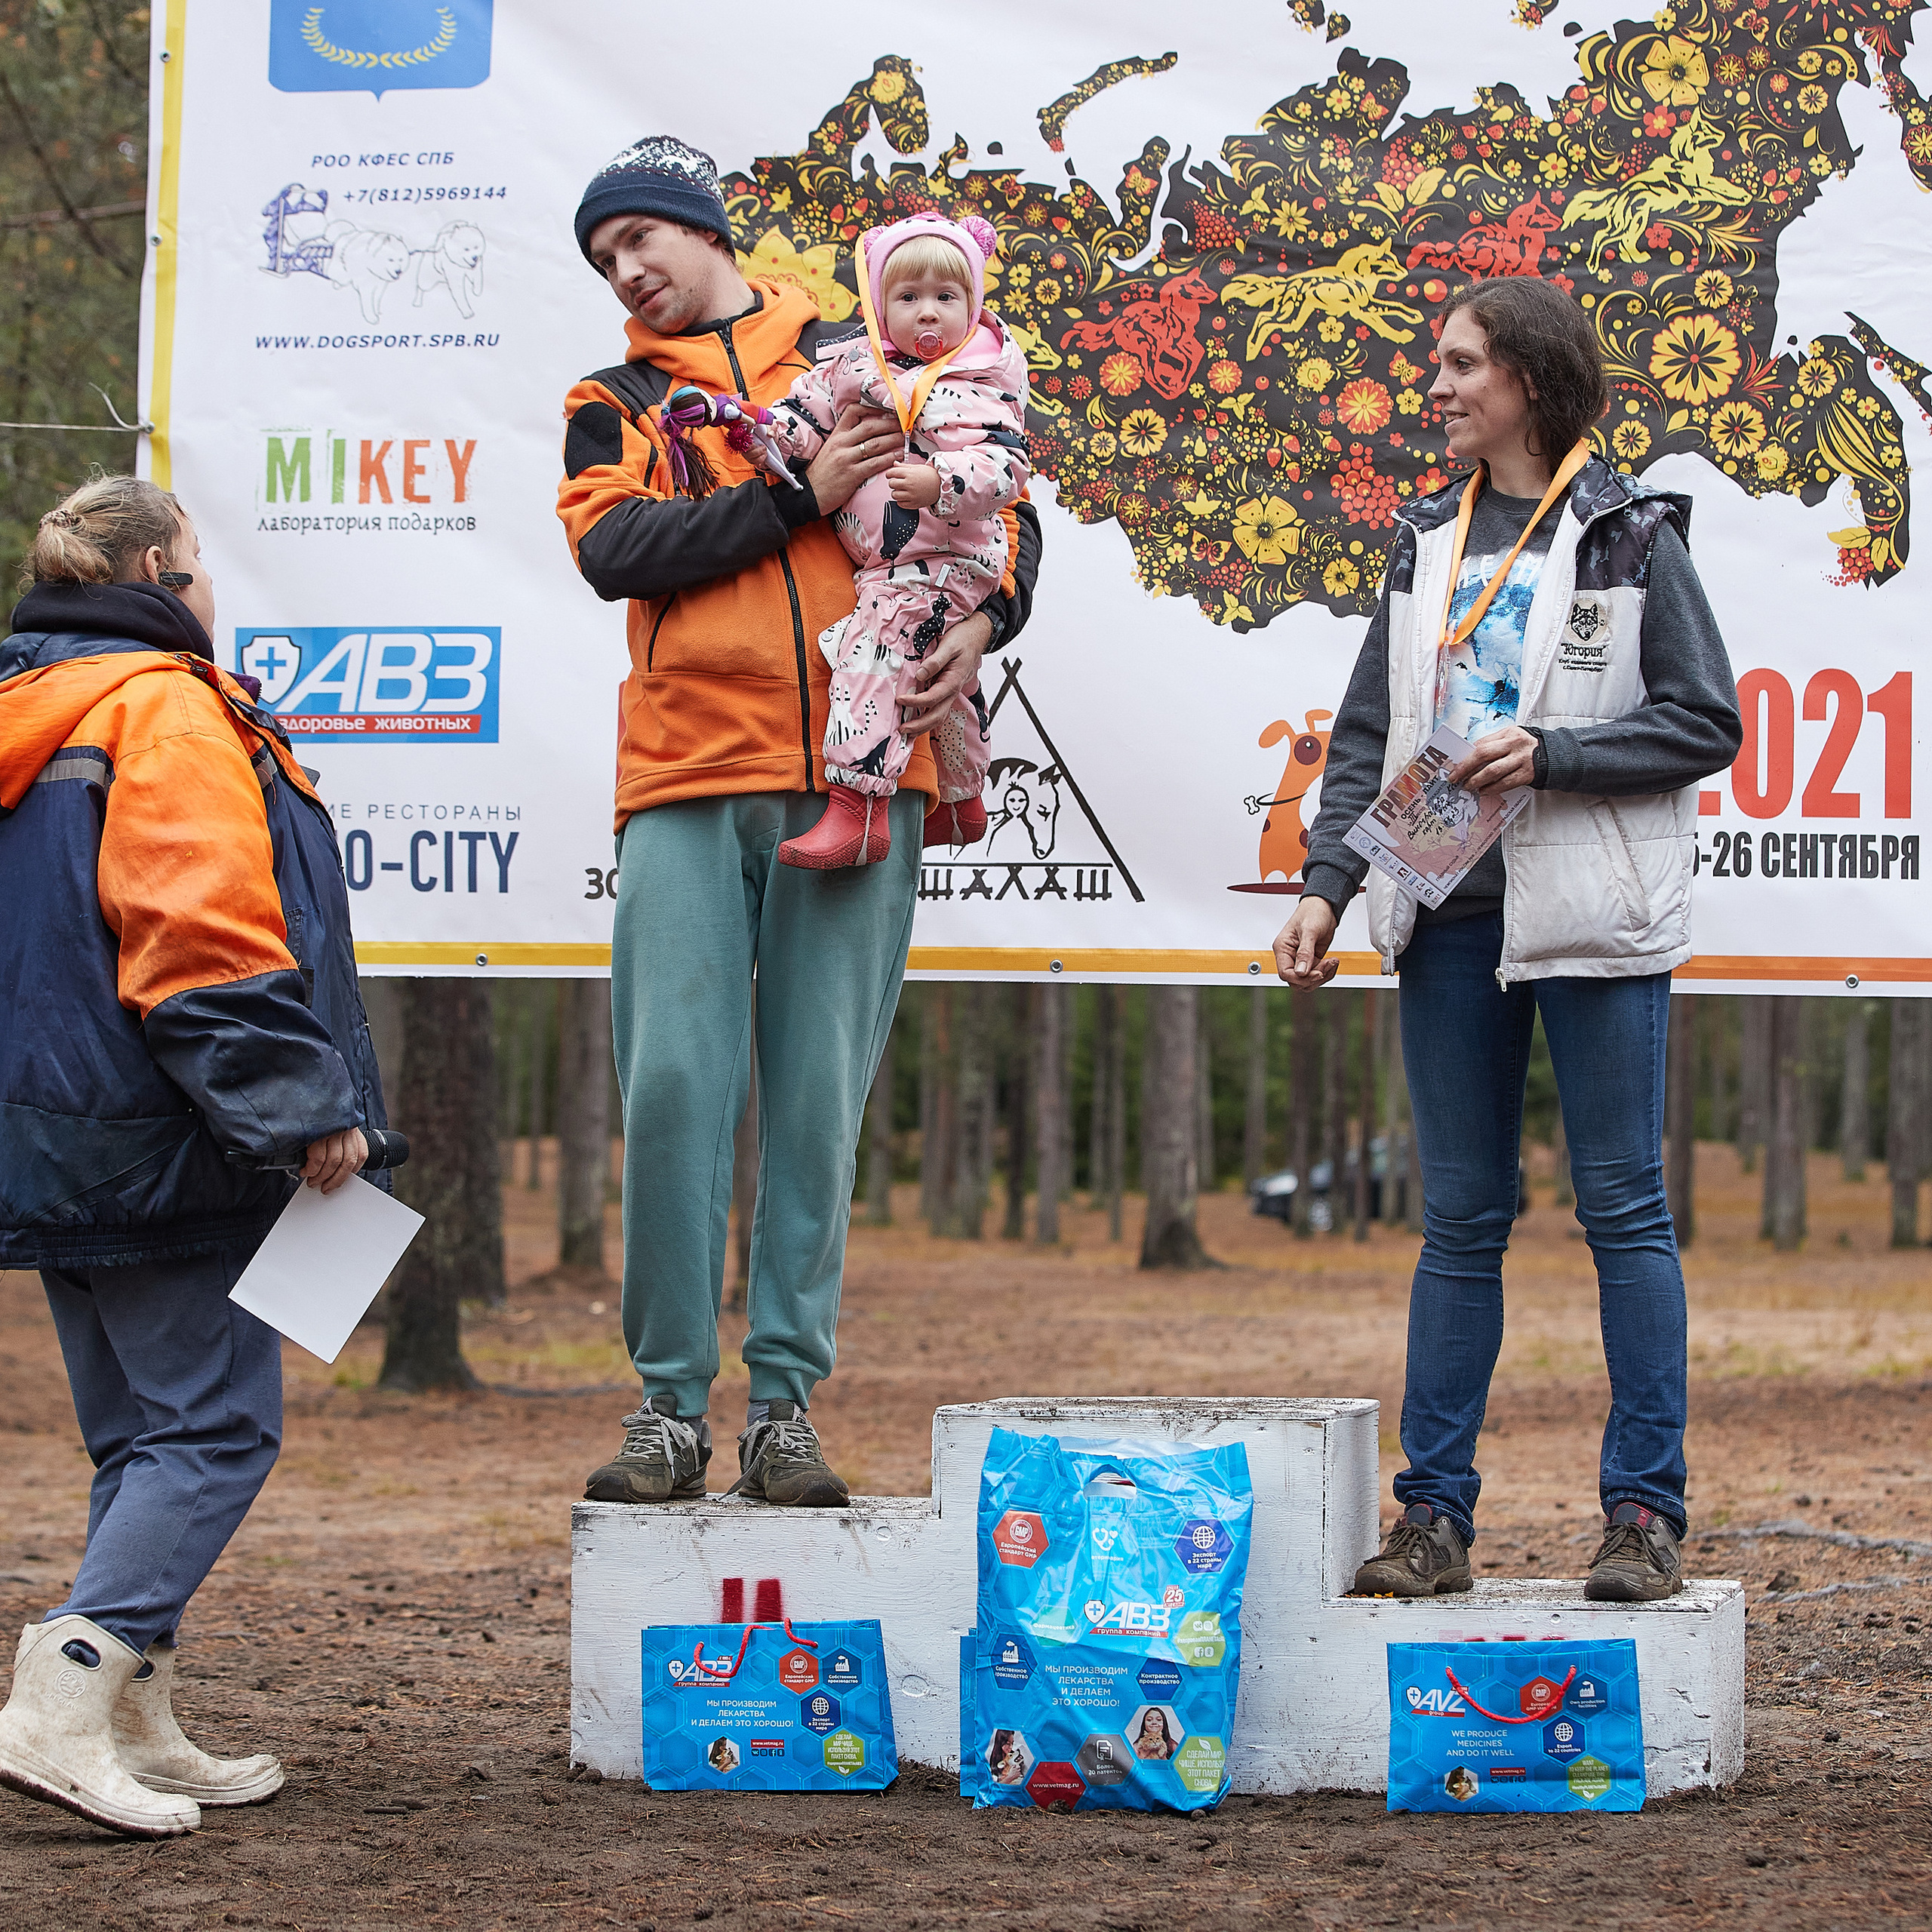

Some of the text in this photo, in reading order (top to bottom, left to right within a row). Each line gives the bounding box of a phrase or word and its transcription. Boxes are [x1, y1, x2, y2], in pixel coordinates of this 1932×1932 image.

[312, 152, 454, 168] РОО КФЕС СПБ
[343, 186, 506, 205] +7(812)5969144
[256, 334, 500, 349] WWW.DOGSPORT.SPB.RU
[266, 436, 478, 504] MIKEY
[257, 513, 476, 535] лаборатория подарков
[280, 717, 471, 733] здоровье животных
[1698, 668, 1912, 819] 021
[1370, 744, 1450, 828] ГРАМОТА
[1401, 796, 1422, 820] ОСЕНЬ
[1423, 774, 1439, 795] ЛАЙТ
[368, 804, 521, 821] РЕСТОРАНЫ
[345, 829, 520, 894] O-CITY
[1761, 831, 1920, 880] СЕНТЯБРЯ
[918, 866, 1112, 901] ШАЛАШ
[1015, 1524, 1029, 1538] GMP
[1001, 1542, 1037, 1553] Европейский
[1166, 1589, 1183, 1603] 25
[1125, 1629, 1161, 1637] компаний
[995, 1666, 1027, 1674] Собственное
[1044, 1665, 1128, 1675] МЫ ПРОИЗВОДИМ
[1058, 1676, 1114, 1685] ЛЕКАРСТВА
[1069, 1687, 1111, 1697] ДЕЛАЕМ
[721, 1700, 777, 1708] ПРОИЗВОДИМ
[1073, 1698, 1120, 1706] ХОРОШО!
[1415, 1689, 1468, 1712] AVZ
[1467, 1729, 1508, 1737] PRODUCE
[1186, 1750, 1210, 1758] СДЕЛАЙ
[1197, 1760, 1224, 1768] ИСПОЛЬЗ
[1187, 1769, 1220, 1777] ЭТОТ ПАКЕТ
